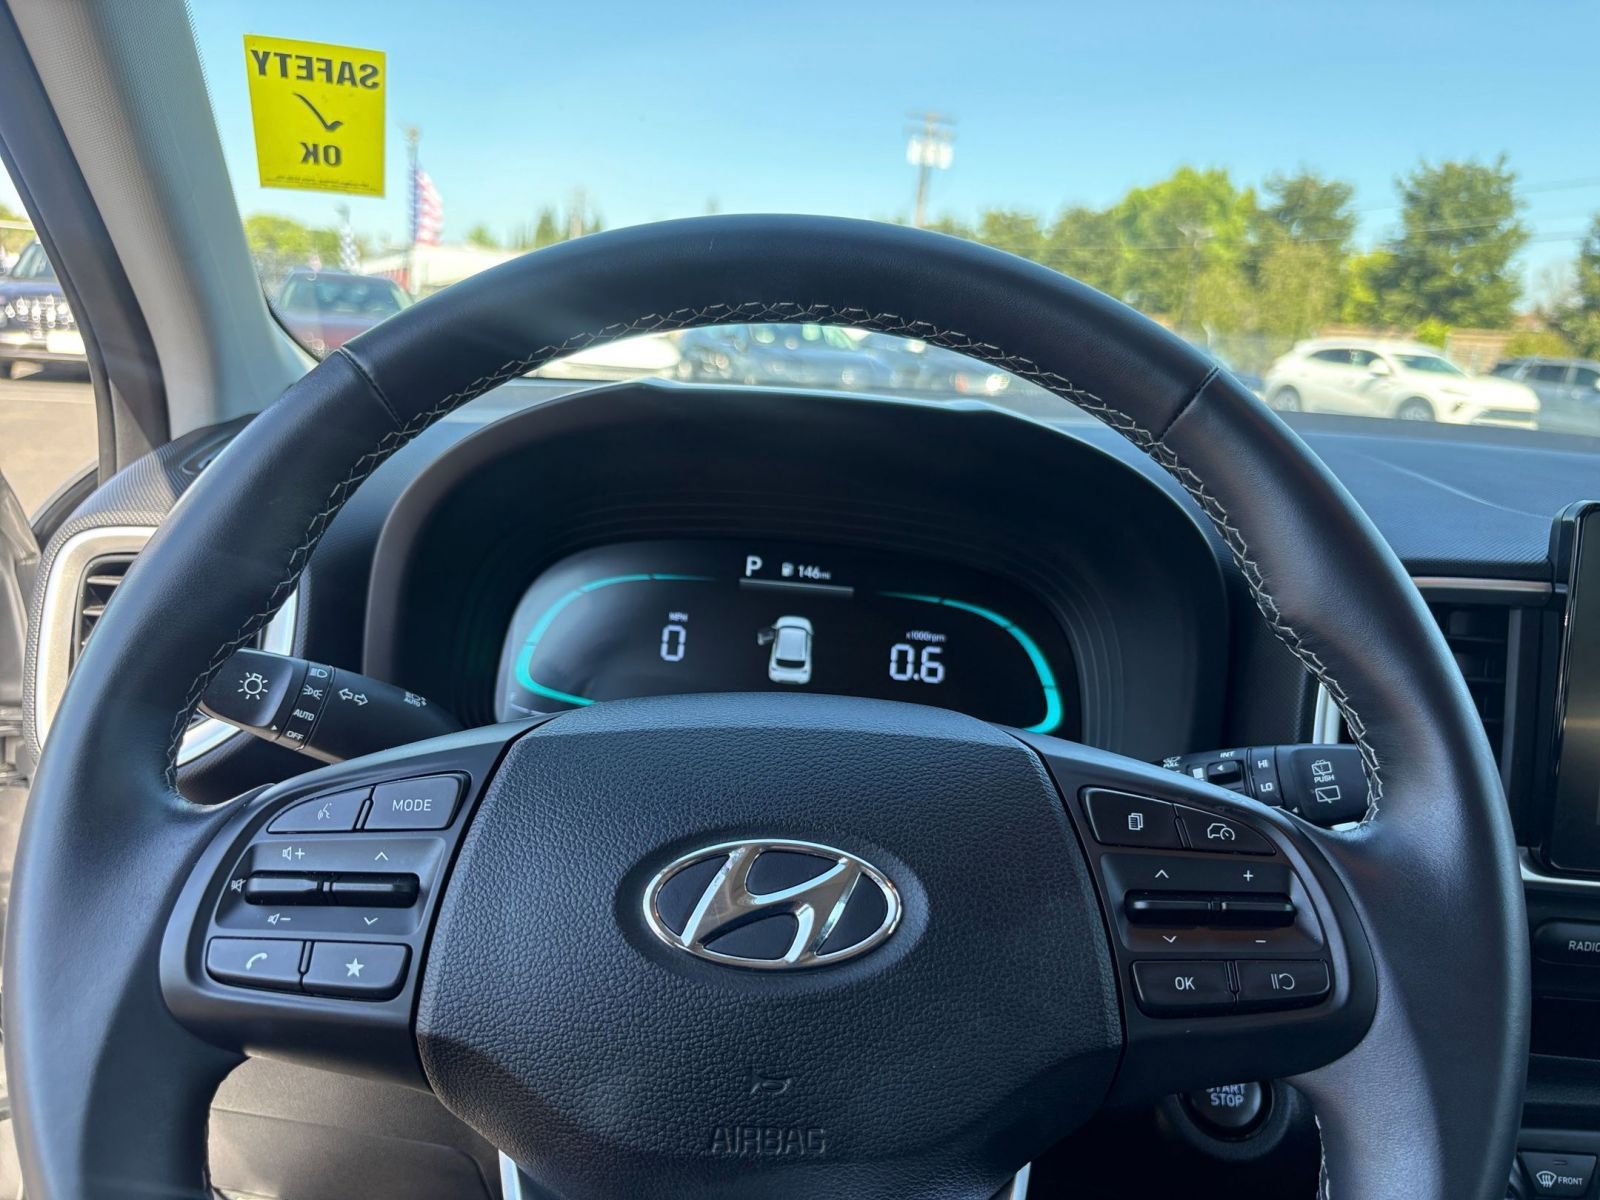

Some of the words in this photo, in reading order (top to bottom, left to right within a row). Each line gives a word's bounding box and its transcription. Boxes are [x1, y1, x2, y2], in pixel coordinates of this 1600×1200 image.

[745, 555, 762, 577] P
[660, 624, 686, 661] 0
[889, 643, 945, 684] 0.6
[293, 709, 315, 721] AUTO
[286, 730, 304, 740] OFF
[1257, 760, 1269, 769] HI
[1314, 774, 1335, 783] PUSH
[1260, 783, 1273, 793] LO
[392, 799, 432, 811] MODE
[1175, 976, 1195, 990] OK
[1210, 1093, 1244, 1107] STOP
[711, 1127, 826, 1155] AIRBAG
[1558, 1176, 1583, 1186] FRONT
